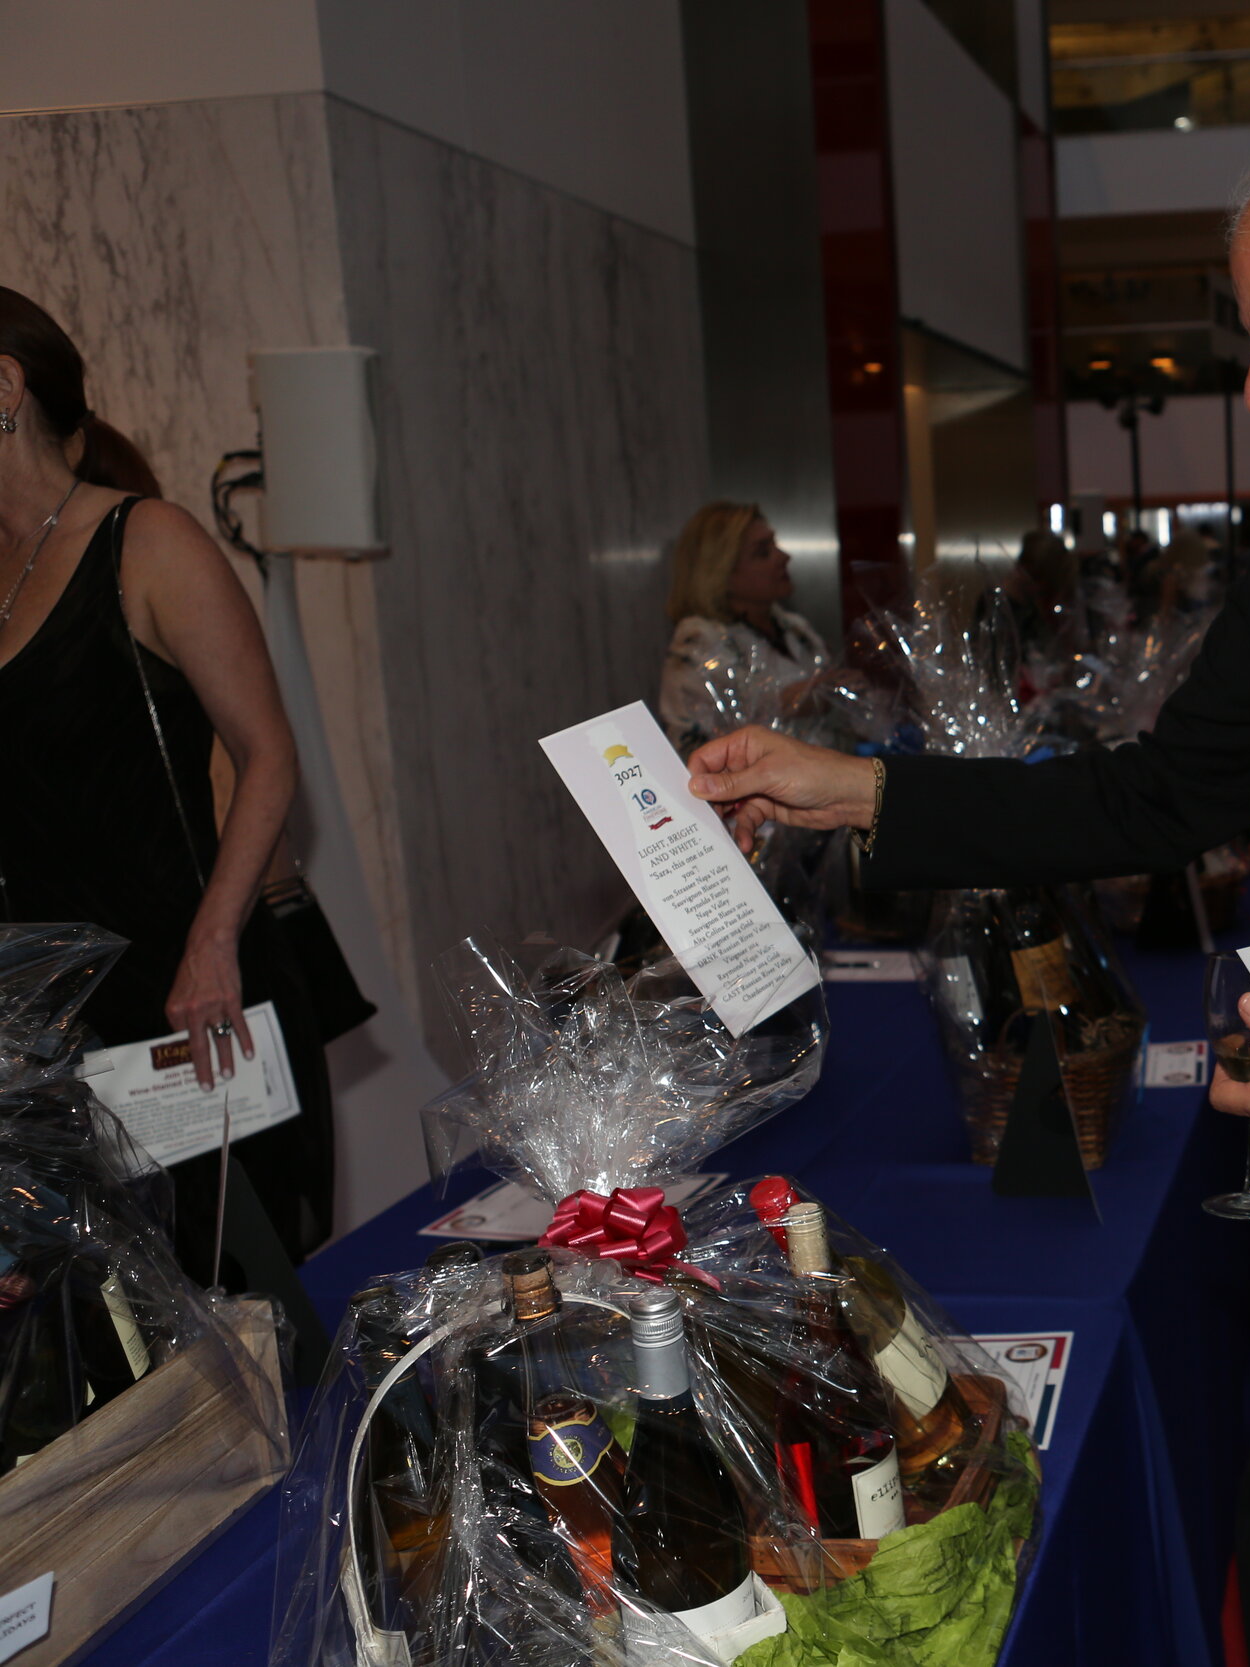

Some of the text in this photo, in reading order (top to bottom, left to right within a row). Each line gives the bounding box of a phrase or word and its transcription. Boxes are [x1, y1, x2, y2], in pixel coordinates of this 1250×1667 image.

[615, 765, 642, 786] 3027
[632, 788, 657, 812] 10
[638, 840, 669, 858] LIGHT,
[667, 823, 698, 844] BRIGHT
[651, 853, 669, 868] AND
[669, 837, 698, 856] WHITE
[672, 860, 685, 870] this
[686, 854, 697, 863] one
[696, 849, 705, 858] is
[703, 845, 714, 854] for
[662, 865, 728, 902] von Strasser Napa Valley
[672, 891, 702, 909] Sauvignon
[684, 887, 729, 914] Reynolds Family
[696, 899, 729, 920] Napa Valley
[688, 917, 718, 936] Sauvignon
[693, 909, 754, 948] Alta Colina Paso Robles
[705, 935, 729, 950] Viognier
[740, 919, 754, 930] Gold
[718, 941, 740, 955] Russian
[739, 933, 753, 942] River
[753, 923, 771, 934] Valley
[717, 962, 744, 981] Raymond
[743, 954, 758, 964] Napa
[722, 948, 747, 964] Viognier
[767, 951, 780, 962] Gold
[723, 957, 791, 1002] CAST Russian River Valley
[743, 981, 774, 1002] Chardonnay
